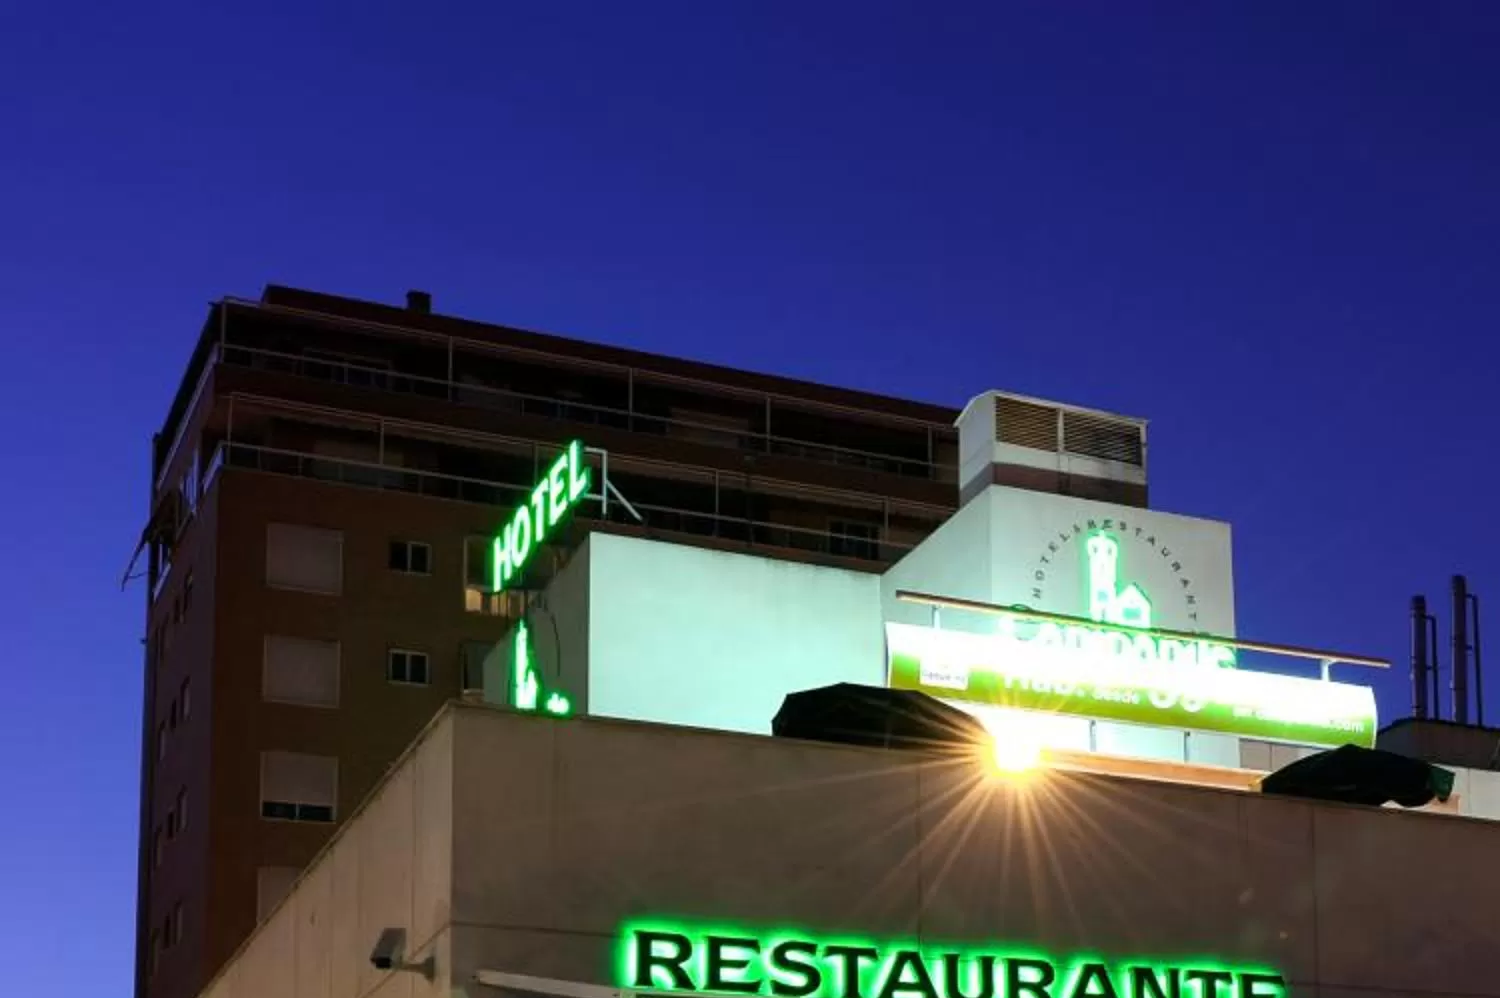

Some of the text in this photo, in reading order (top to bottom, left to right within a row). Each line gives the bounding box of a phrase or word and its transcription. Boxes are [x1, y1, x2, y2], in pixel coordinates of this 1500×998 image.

[491, 438, 590, 593] HOTEL
[1030, 530, 1070, 600] HOTEL
[1086, 518, 1199, 622] RESTAURANT
